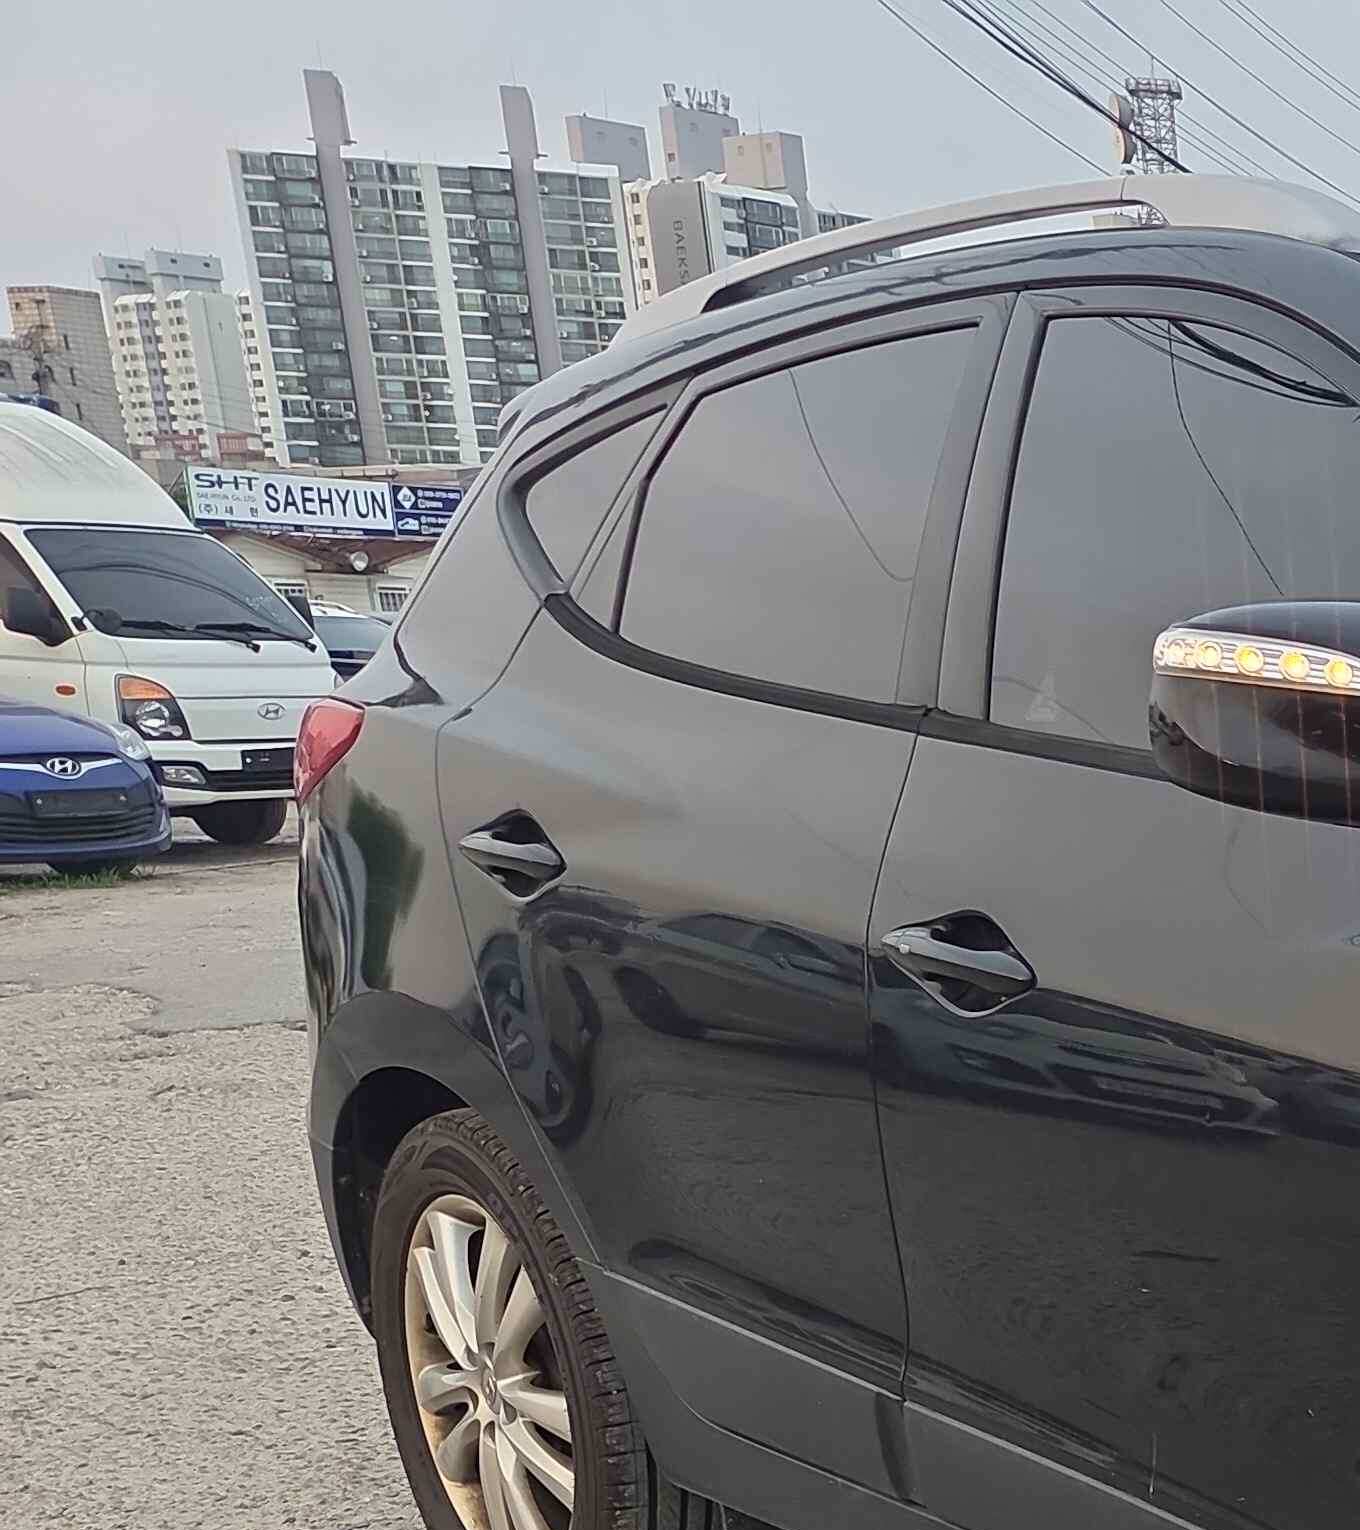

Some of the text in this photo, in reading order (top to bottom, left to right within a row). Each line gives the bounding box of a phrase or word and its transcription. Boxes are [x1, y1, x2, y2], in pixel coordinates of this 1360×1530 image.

[672, 220, 690, 285] BAEKS
[194, 472, 259, 491] SHT
[264, 482, 387, 519] SAEHYUN
